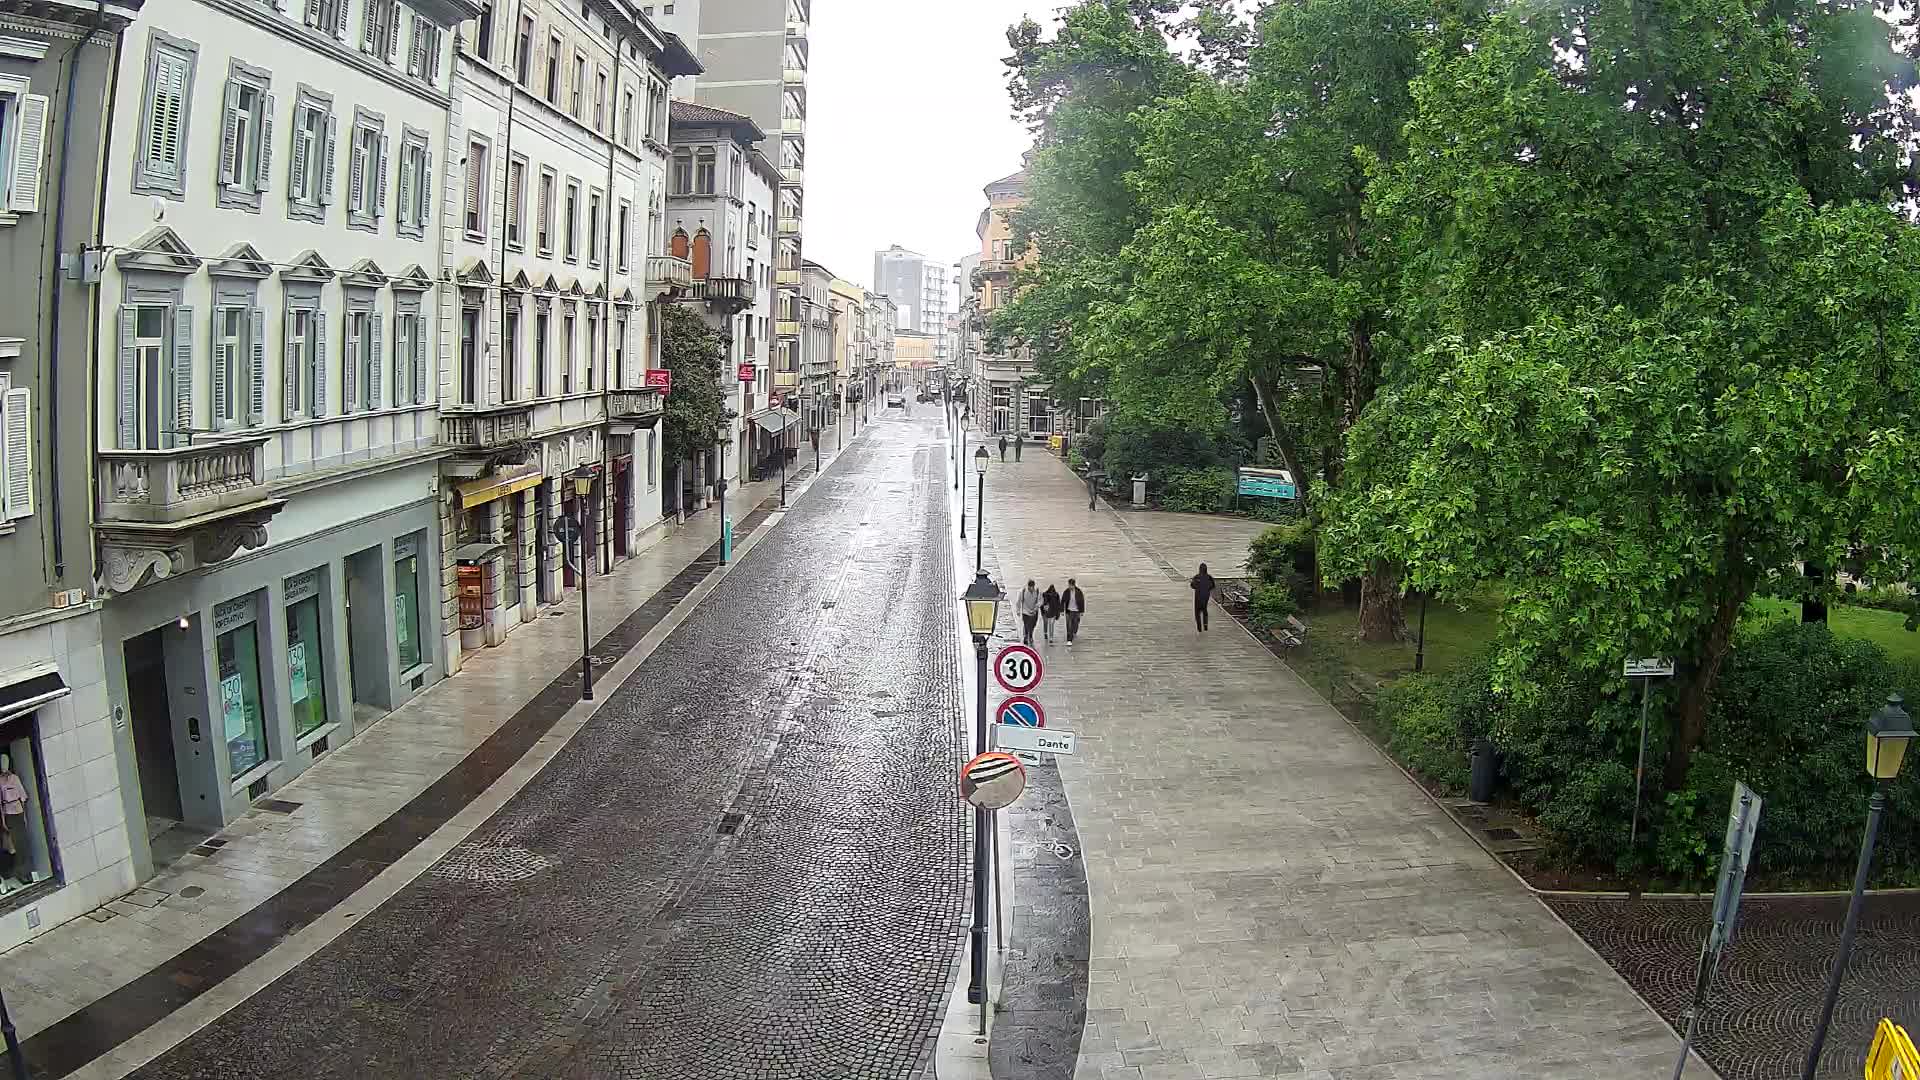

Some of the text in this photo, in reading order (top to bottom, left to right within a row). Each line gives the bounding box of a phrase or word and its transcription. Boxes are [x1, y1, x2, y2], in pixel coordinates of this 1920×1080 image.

[1005, 659, 1033, 680] 30
[222, 678, 240, 701] 130
[1038, 738, 1069, 749] Dante
